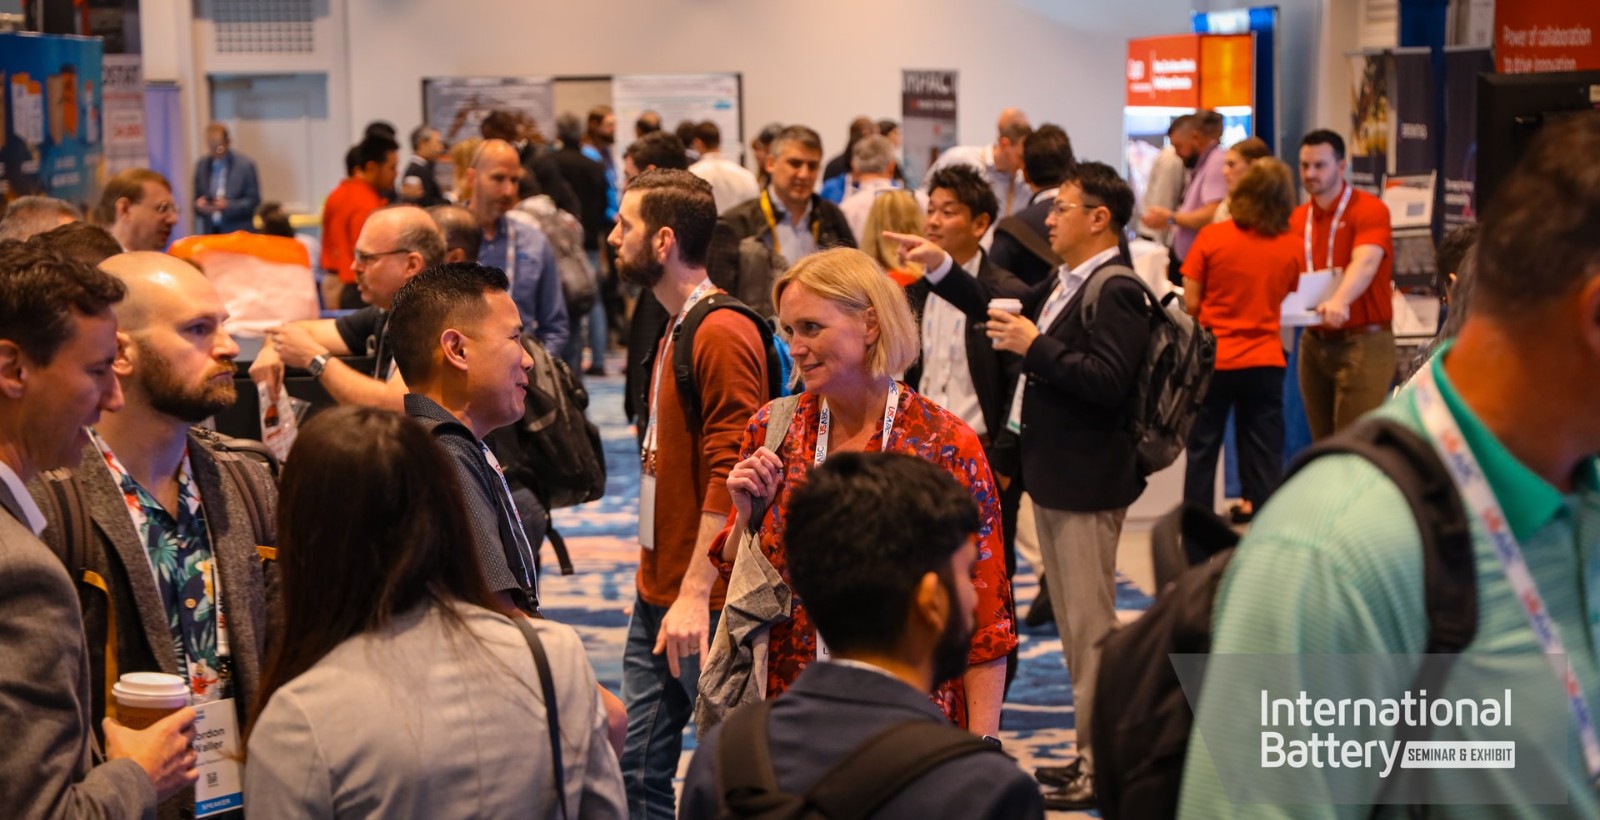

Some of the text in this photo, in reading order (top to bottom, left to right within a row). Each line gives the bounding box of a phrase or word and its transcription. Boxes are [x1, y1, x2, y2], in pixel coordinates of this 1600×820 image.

[1503, 25, 1526, 47] Power
[820, 408, 828, 435] USABC
[885, 406, 895, 434] USABC
[195, 728, 225, 741] ordon
